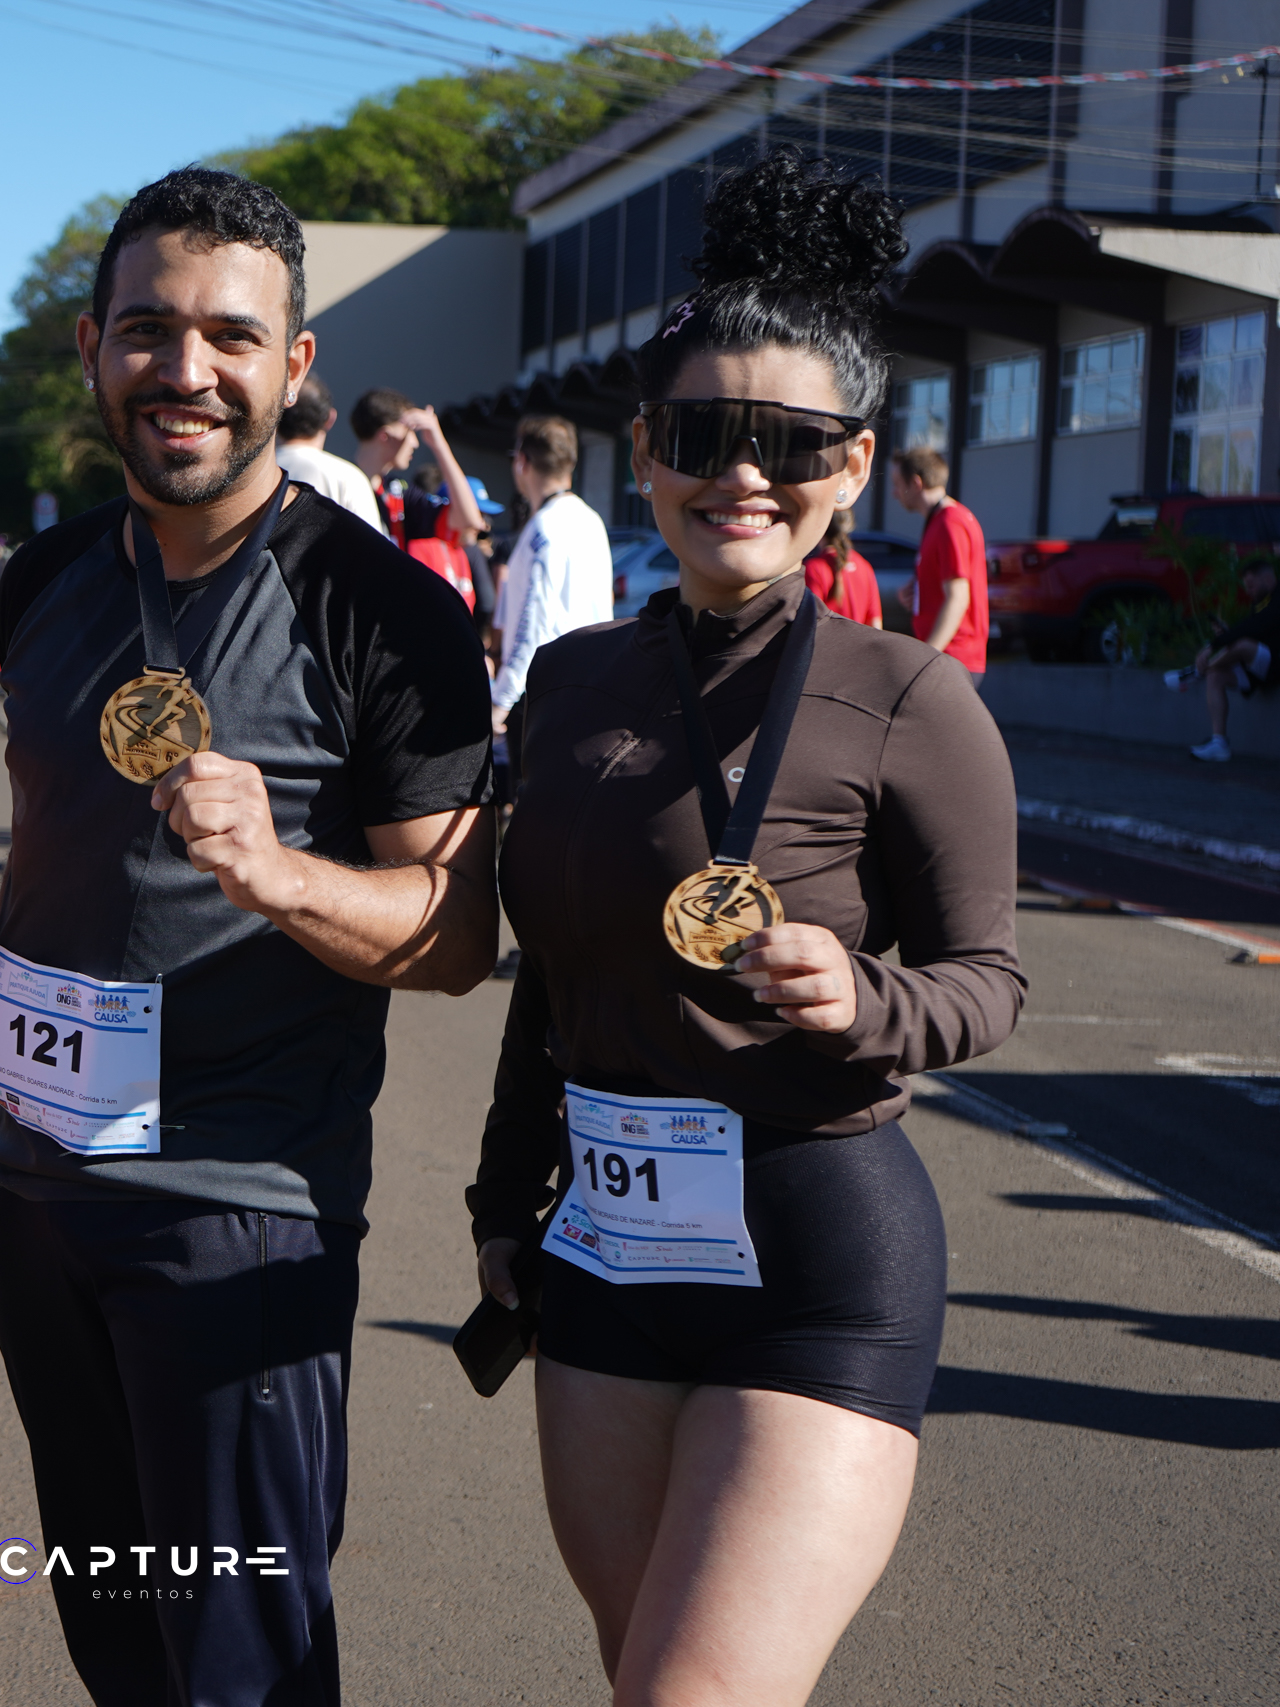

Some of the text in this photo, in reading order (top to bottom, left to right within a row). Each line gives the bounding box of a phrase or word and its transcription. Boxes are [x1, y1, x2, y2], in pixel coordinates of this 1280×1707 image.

[56, 993, 71, 1005] ONG
[94, 1012, 128, 1023] CAUSA
[9, 1014, 83, 1074] 121
[6, 1069, 26, 1082] GABRIEL
[27, 1075, 48, 1089] SOARES
[48, 1084, 75, 1097] ANDRADE
[78, 1093, 99, 1104] Corrida
[621, 1123, 636, 1134] ONG
[671, 1134, 708, 1145] CAUSA
[583, 1147, 660, 1202] 191
[629, 1217, 656, 1227] NAZARÉ
[661, 1221, 684, 1229] Corrida
